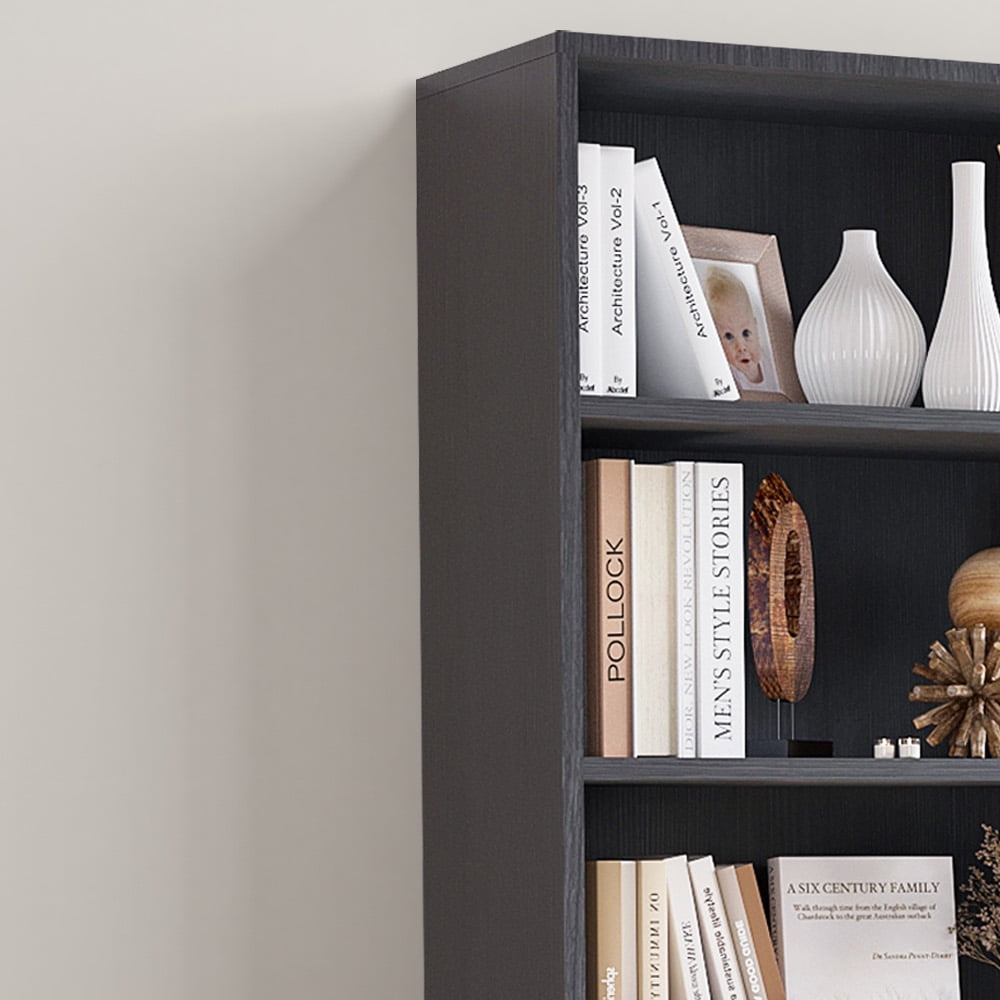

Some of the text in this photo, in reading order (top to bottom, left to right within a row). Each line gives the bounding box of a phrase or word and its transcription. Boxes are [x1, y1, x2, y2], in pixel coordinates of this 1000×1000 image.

[578, 184, 589, 333] Architecture Vol-3
[610, 188, 623, 336] Architecture Vol-2
[651, 200, 708, 338] Architecture Vol-1
[680, 470, 692, 590] REVOLUTION
[606, 538, 626, 682] POLLOCK
[681, 598, 692, 647] LOOK
[681, 658, 693, 695] NEW
[711, 476, 732, 741] MEN'S STYLE STORIES
[788, 882, 940, 894] A SIX CENTURY FAMILY
